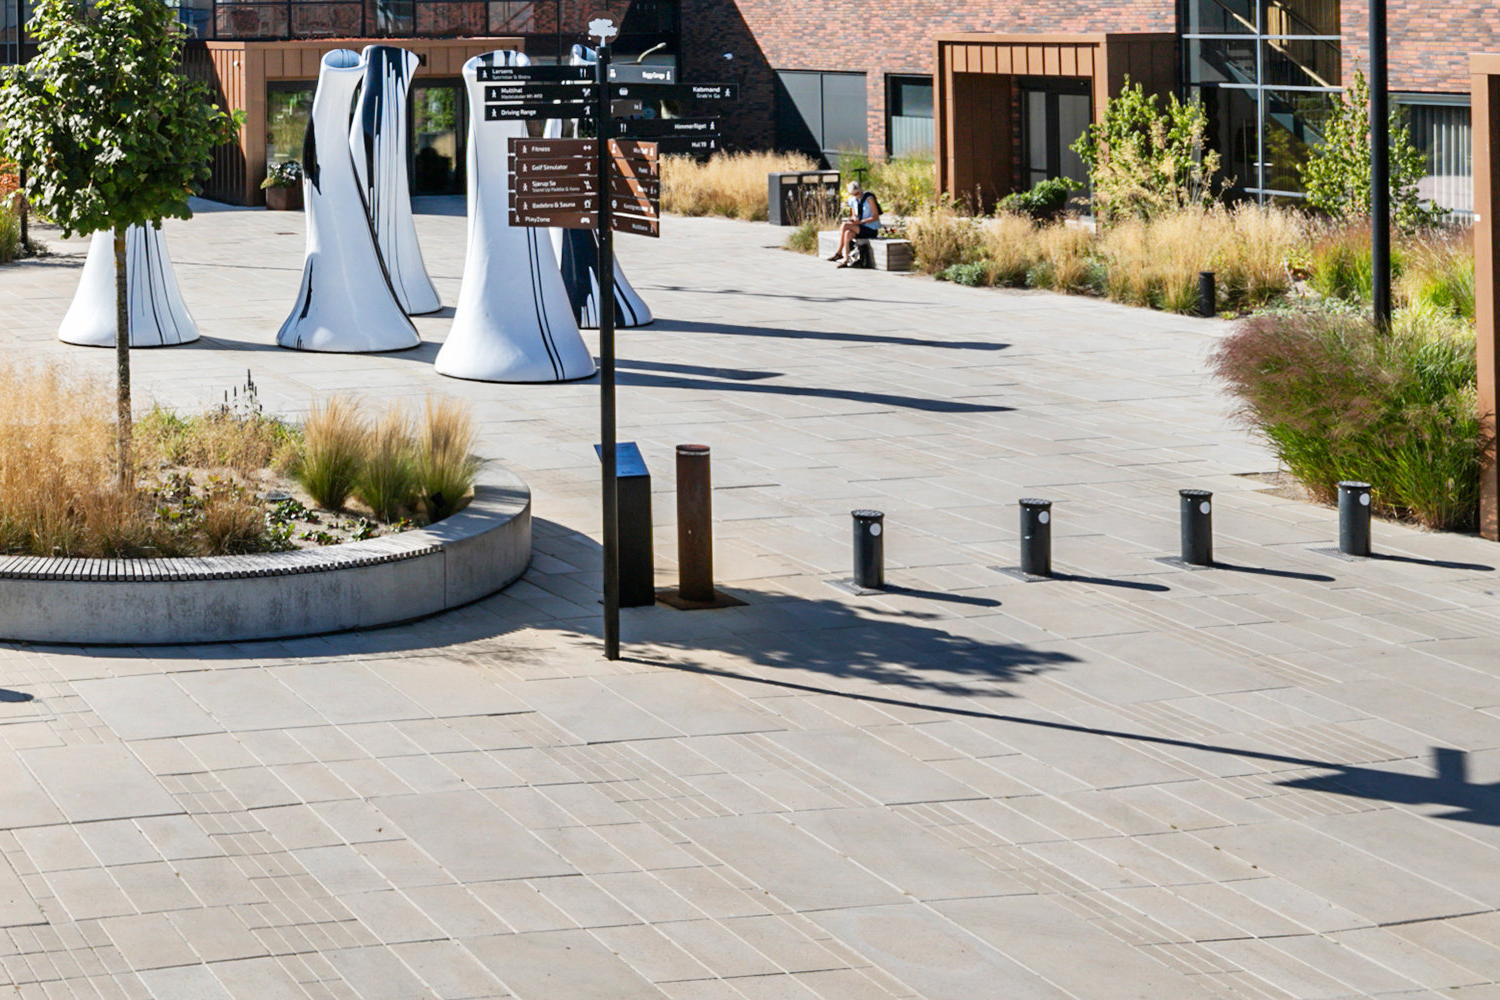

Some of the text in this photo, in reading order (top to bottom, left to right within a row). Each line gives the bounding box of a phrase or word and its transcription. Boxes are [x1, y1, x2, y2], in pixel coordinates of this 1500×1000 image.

[501, 109, 537, 117] Driving Range
[543, 163, 569, 171] Simulator
[525, 216, 551, 224] PlayZone
